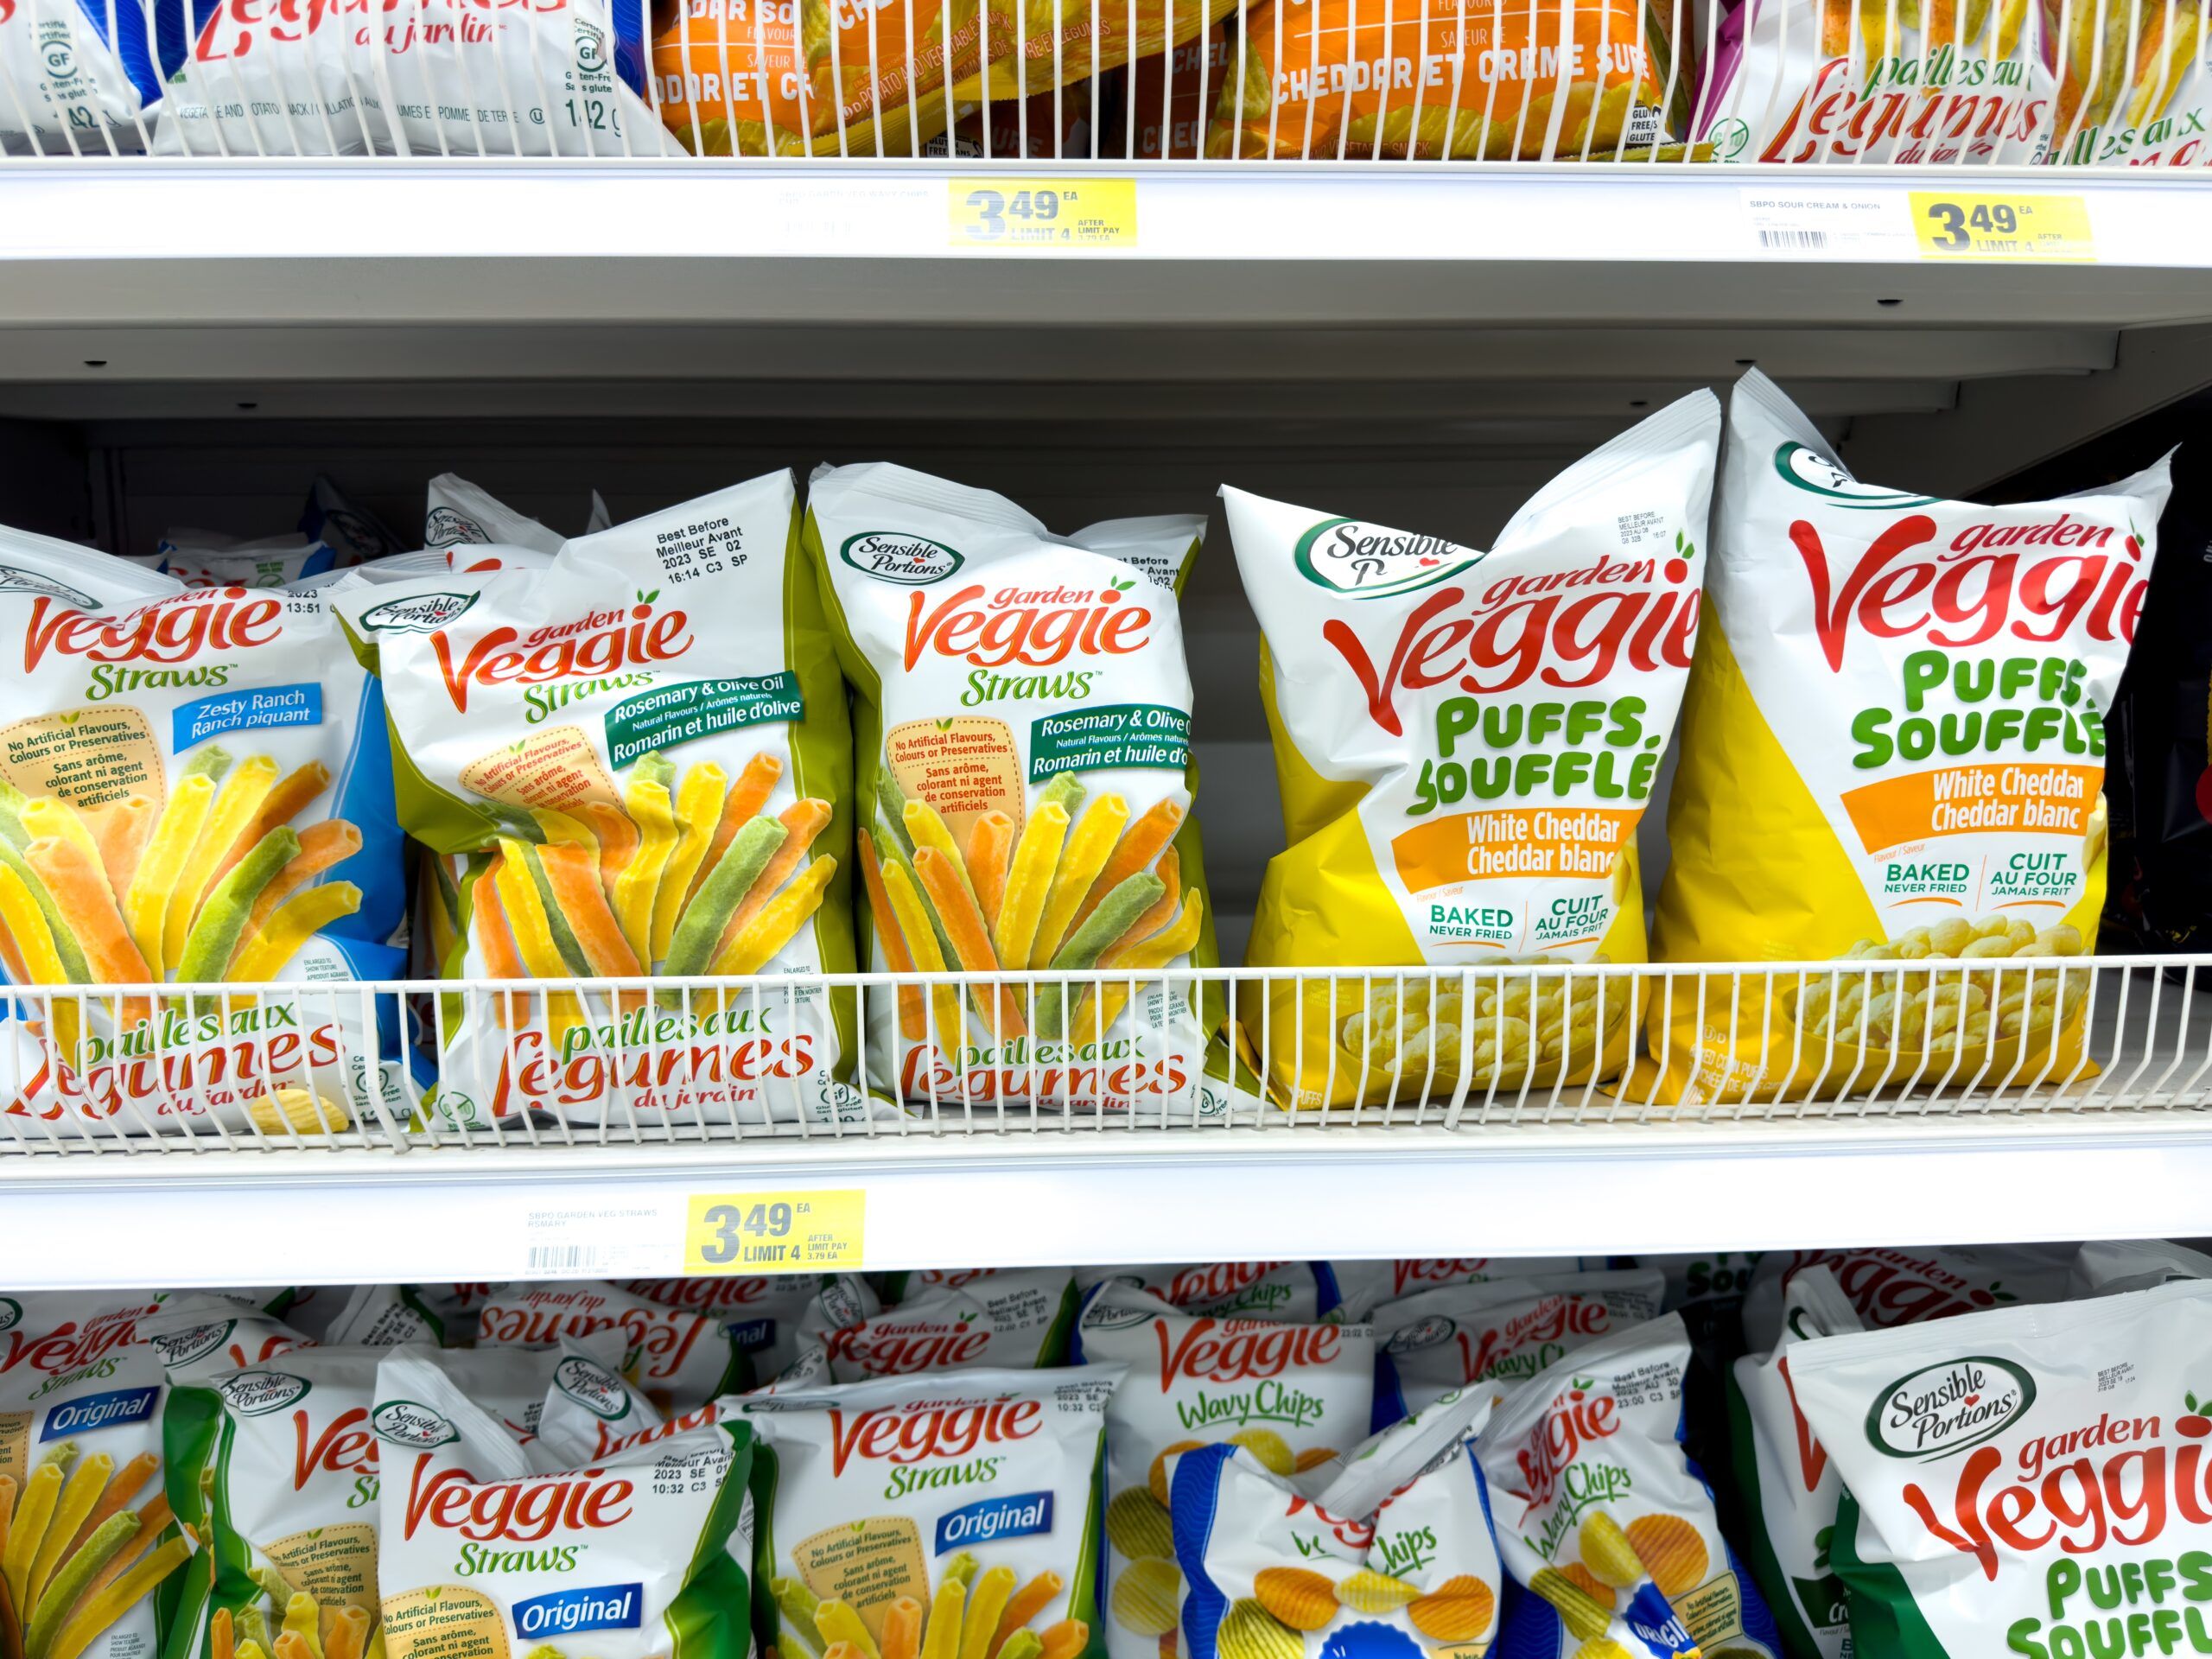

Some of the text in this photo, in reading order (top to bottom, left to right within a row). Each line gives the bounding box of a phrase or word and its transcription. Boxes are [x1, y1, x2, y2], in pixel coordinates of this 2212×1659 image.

[1273, 58, 1413, 105] CHEDDAR
[1425, 53, 1465, 87] ET
[225, 104, 244, 118] AND
[439, 105, 489, 122] POMME DE
[1064, 192, 1077, 200] EA
[2018, 206, 2033, 215] EA
[1011, 228, 1071, 240] LIMIT 4
[1977, 240, 2018, 251] LIMIT
[657, 517, 729, 543] Best Before
[1634, 512, 1655, 521] BEFORE
[657, 527, 742, 558] Meilleur Avant
[859, 537, 938, 559] Sensible
[1936, 513, 2113, 562] garden
[663, 539, 741, 569] 2023 SE 02
[669, 554, 747, 584] 16:14 C3 SP
[864, 553, 945, 575] Portions
[988, 586, 1094, 608] garden
[1472, 556, 1655, 618] garden
[1789, 515, 2149, 672] Veggie
[287, 603, 320, 613] 13:51
[25, 593, 283, 673] Veggie
[524, 603, 625, 647] garden
[905, 584, 1151, 672] Veggie
[429, 605, 693, 713] Veggie
[1323, 588, 1702, 736] Veggie
[86, 664, 229, 701] Straws
[524, 671, 654, 723] Straws
[961, 670, 1093, 707] Straws
[198, 690, 305, 720] Zesty Ranch
[614, 675, 784, 722] Rosemary & Olive Oil
[632, 715, 663, 731] Natural
[664, 709, 697, 724] Flavours
[707, 696, 737, 709] Arômes
[740, 692, 772, 702] naturels
[8, 721, 130, 751] No Artificial Flavours,
[192, 708, 310, 739] Ranch piquant
[613, 698, 800, 762] Romarin et huile d'olive
[10, 747, 50, 764] Colours
[69, 731, 145, 748] Preservatives
[54, 751, 127, 772] Sans arôme,
[46, 761, 143, 788] colorant ni agent
[58, 772, 148, 798] de conservation
[1932, 766, 2083, 799] White Cheddar
[78, 789, 129, 808] artificiels
[1467, 812, 1619, 843] White Cheddar
[1931, 799, 2078, 831] Cheddar blanc
[1467, 845, 1615, 875] Cheddar blanc
[1887, 863, 1970, 881] BAKED
[2009, 853, 2066, 870] CUIT
[1885, 883, 1967, 893] NEVER FRIED
[1991, 870, 2076, 886] AU FOUR
[1992, 886, 2070, 896] JAMAIS FRIT
[1431, 906, 1513, 927] BAKED
[1535, 907, 1608, 931] AU FOUR
[1551, 896, 1604, 916] CUIT
[1430, 925, 1512, 939] NEVER FRIED
[1536, 923, 1604, 941] JAMAIS FRIT
[77, 1001, 297, 1076] pailles aux
[563, 1007, 772, 1065] pailles aux
[797, 1203, 810, 1212] EA
[744, 1245, 800, 1262] LIMIT 4
[873, 1321, 949, 1338] garden
[1154, 1319, 1341, 1394] Veggie
[1177, 1380, 1324, 1430] Wavy Chips
[1618, 1397, 1644, 1409] 23:00
[1890, 1363, 1986, 1428] Sensible
[53, 1395, 149, 1430] Original
[1911, 1390, 2012, 1448] Portions
[829, 1397, 1042, 1478] Veggie
[2018, 1414, 2160, 1482] garden
[652, 1482, 706, 1494] 10:32 C3
[654, 1469, 705, 1479] 2023 SE
[884, 1456, 998, 1500] Straws
[1564, 1462, 1631, 1503] Chips
[405, 1452, 633, 1541] Veggie
[944, 1498, 1043, 1541] Original
[454, 1542, 578, 1575] Straws
[522, 1592, 631, 1631] Original
